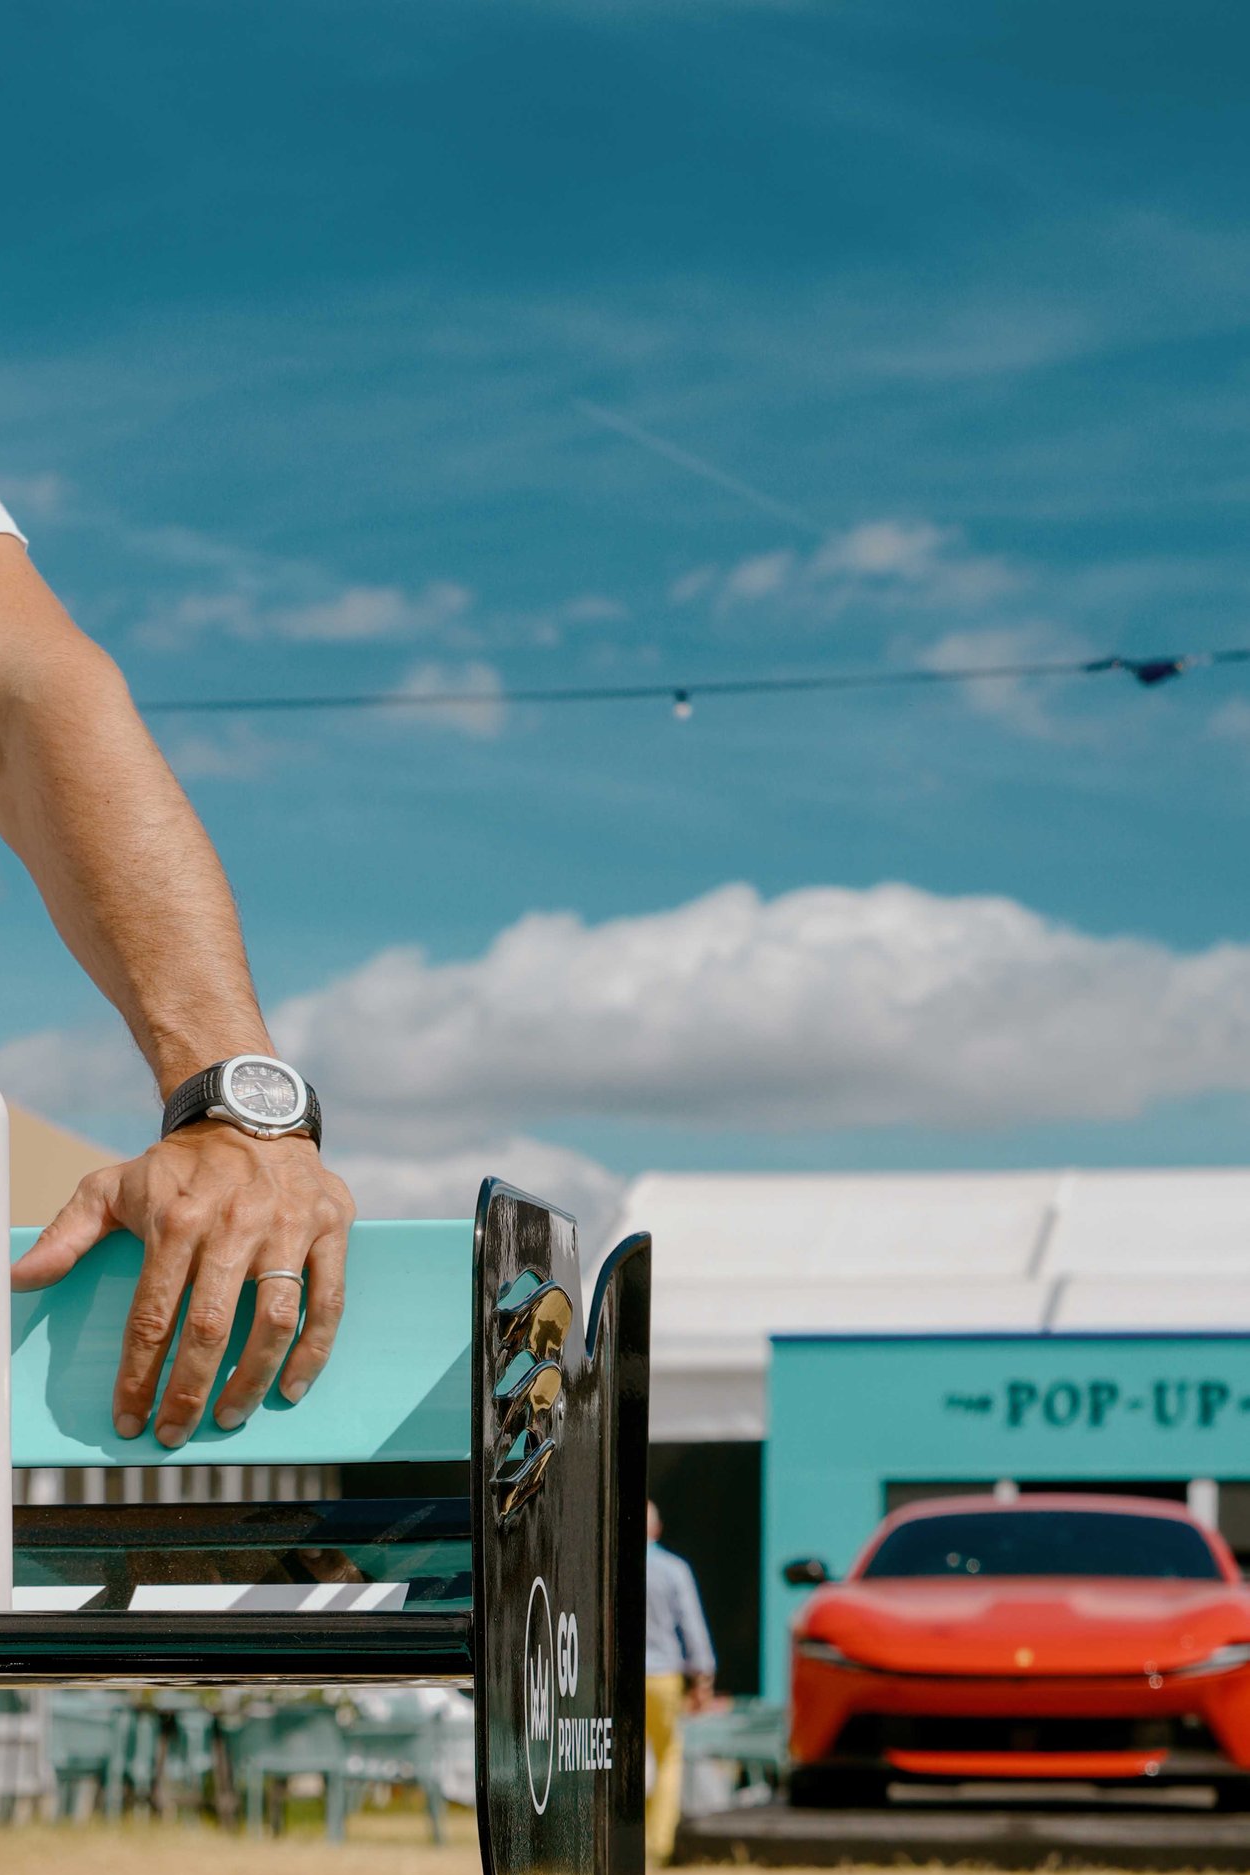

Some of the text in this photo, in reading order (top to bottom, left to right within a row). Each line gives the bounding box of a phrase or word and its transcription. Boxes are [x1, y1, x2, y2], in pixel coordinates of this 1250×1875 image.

[1007, 1379, 1229, 1428] POP-UP
[557, 1612, 578, 1697] GO
[558, 1718, 612, 1772] PRIVILEGE
